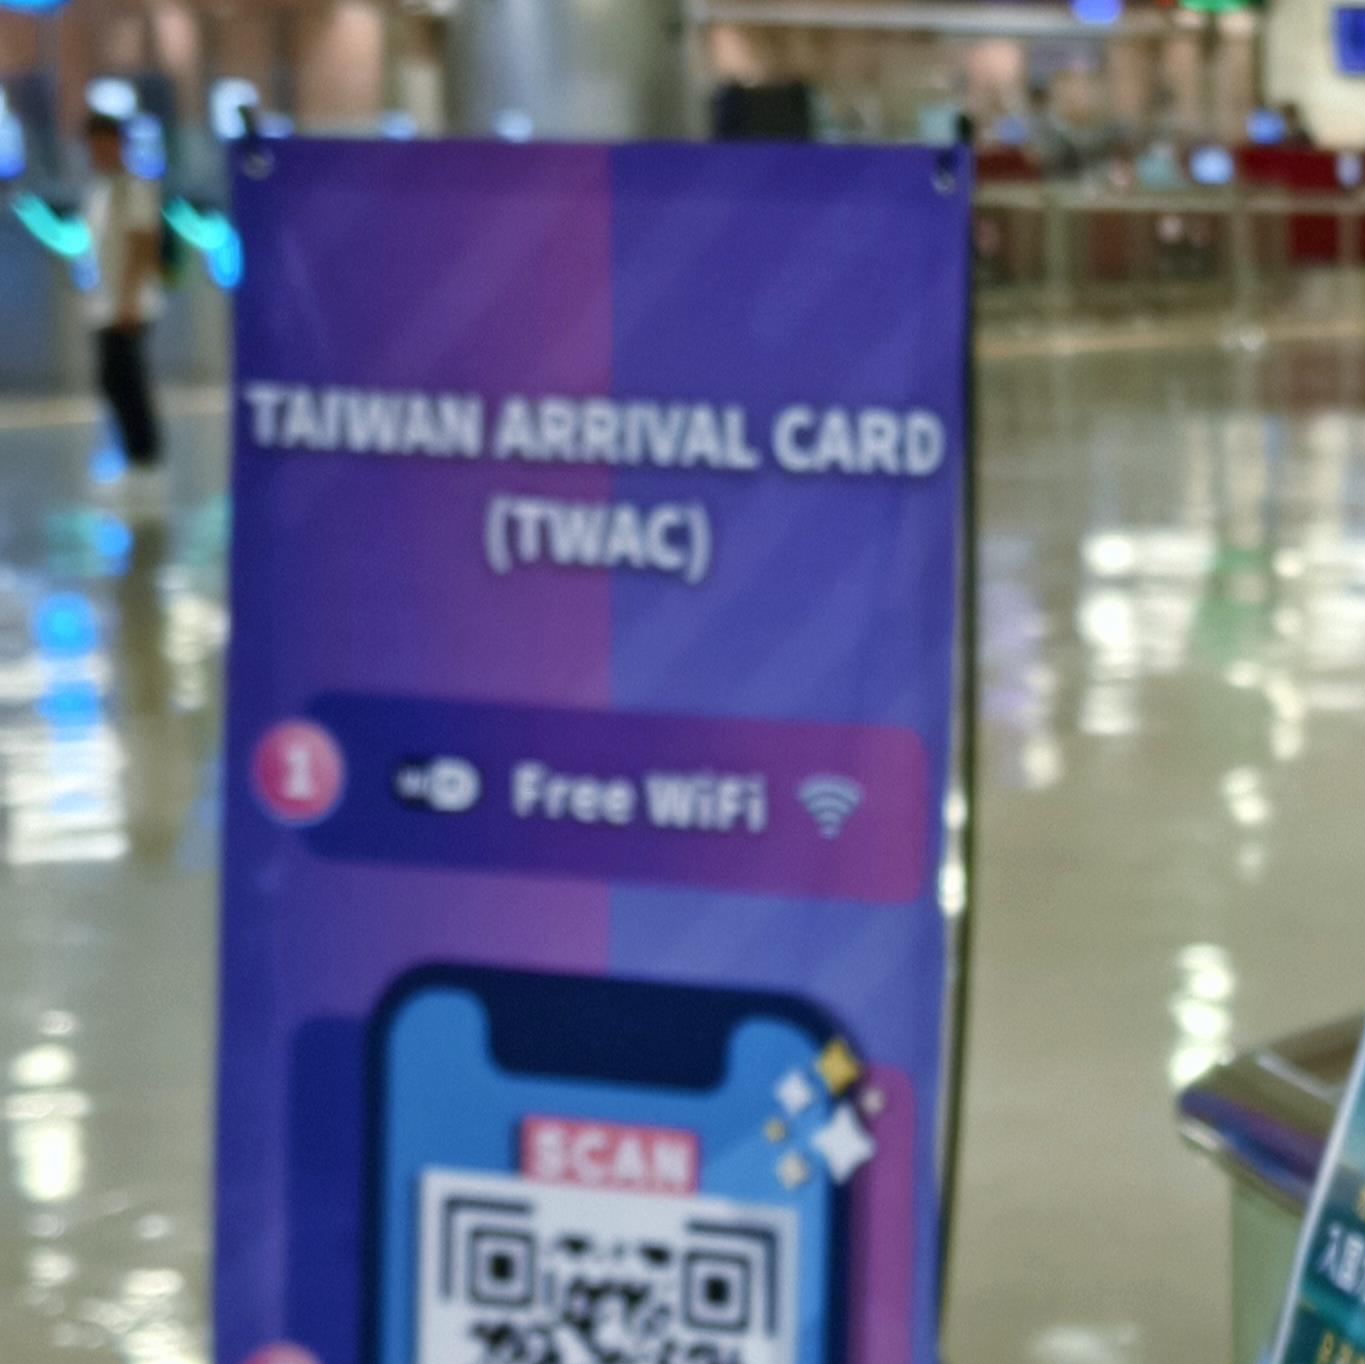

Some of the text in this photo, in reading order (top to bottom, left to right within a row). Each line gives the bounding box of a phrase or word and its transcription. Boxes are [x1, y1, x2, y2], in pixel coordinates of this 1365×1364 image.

[247, 383, 945, 476] TAIWAN ARRIVAL CARD
[484, 494, 711, 584] (TWAC)
[511, 762, 634, 826] Free
[646, 772, 767, 833] WiFi
[531, 1123, 693, 1184] SCAN
